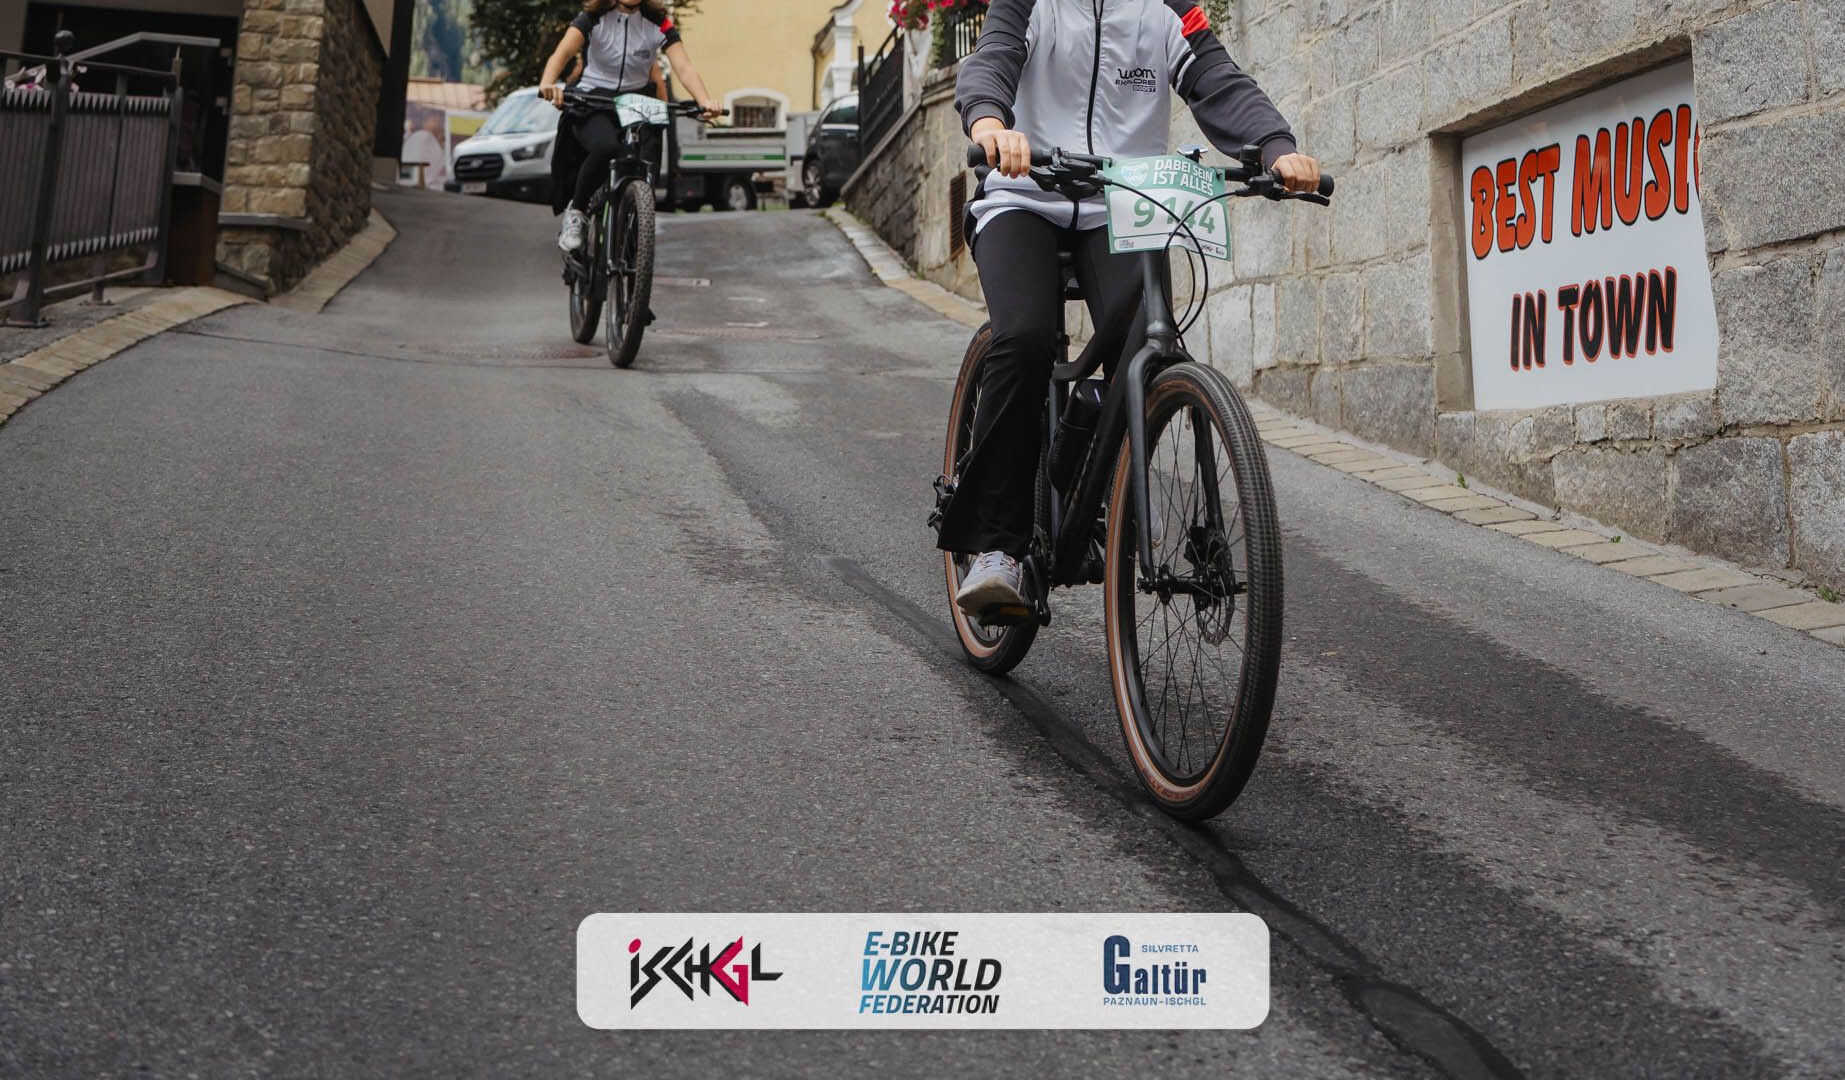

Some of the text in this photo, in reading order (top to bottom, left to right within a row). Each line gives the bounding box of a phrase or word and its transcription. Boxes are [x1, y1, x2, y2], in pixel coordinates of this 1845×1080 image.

[1152, 171, 1178, 185] IST
[1179, 174, 1214, 197] ALLES
[1153, 159, 1192, 176] DABEI
[1192, 163, 1213, 183] SEIN
[1471, 104, 1701, 260] BEST MUSI
[1133, 196, 1215, 235] 9144
[1510, 266, 1677, 371] IN TOWN
